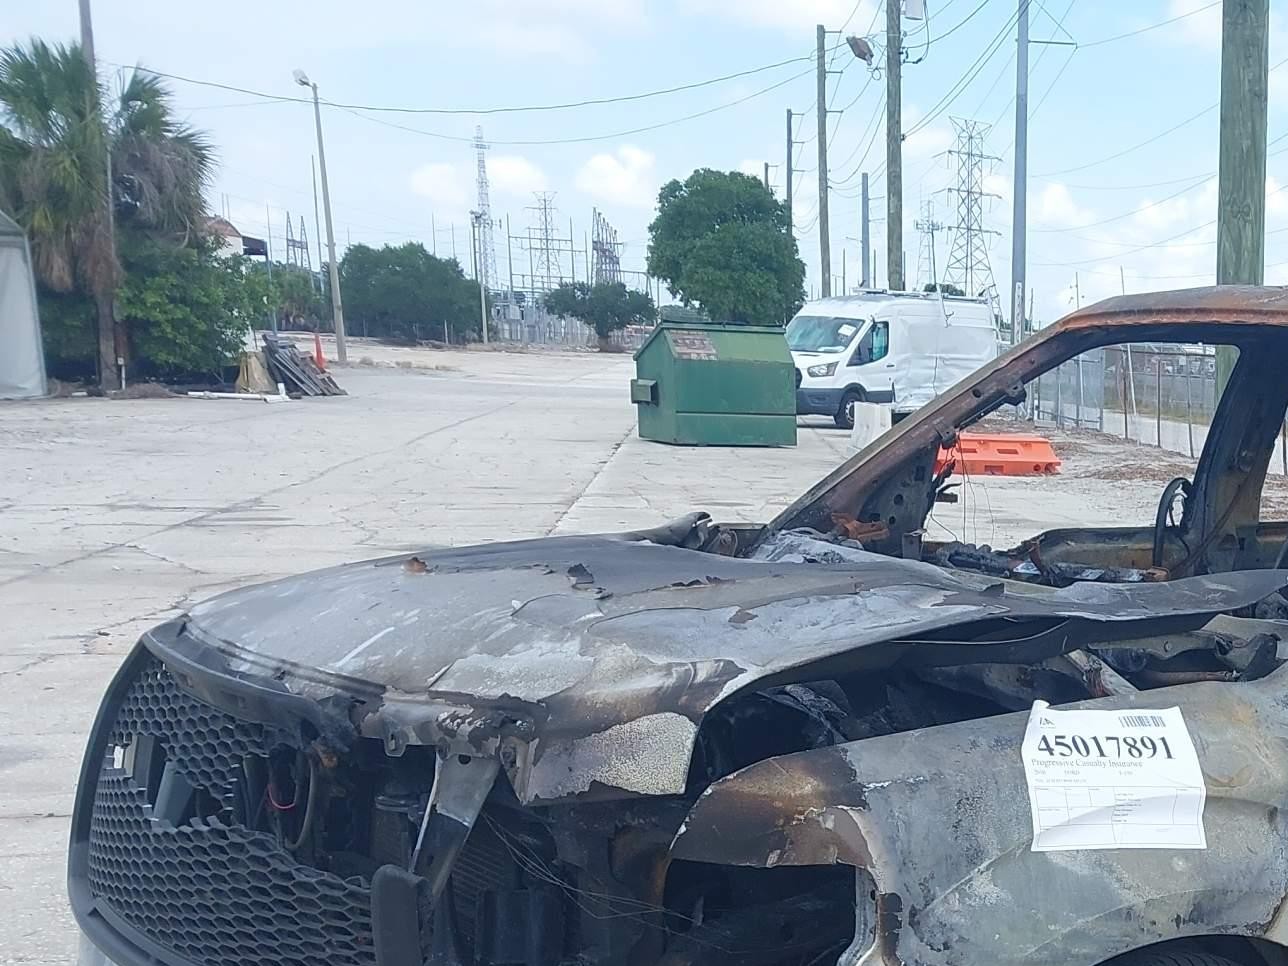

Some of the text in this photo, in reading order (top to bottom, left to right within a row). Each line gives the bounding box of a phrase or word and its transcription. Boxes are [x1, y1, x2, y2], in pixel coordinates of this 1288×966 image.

[1037, 733, 1176, 760] 45017891
[1031, 758, 1074, 768] Progressive
[1075, 759, 1106, 769] Casualty
